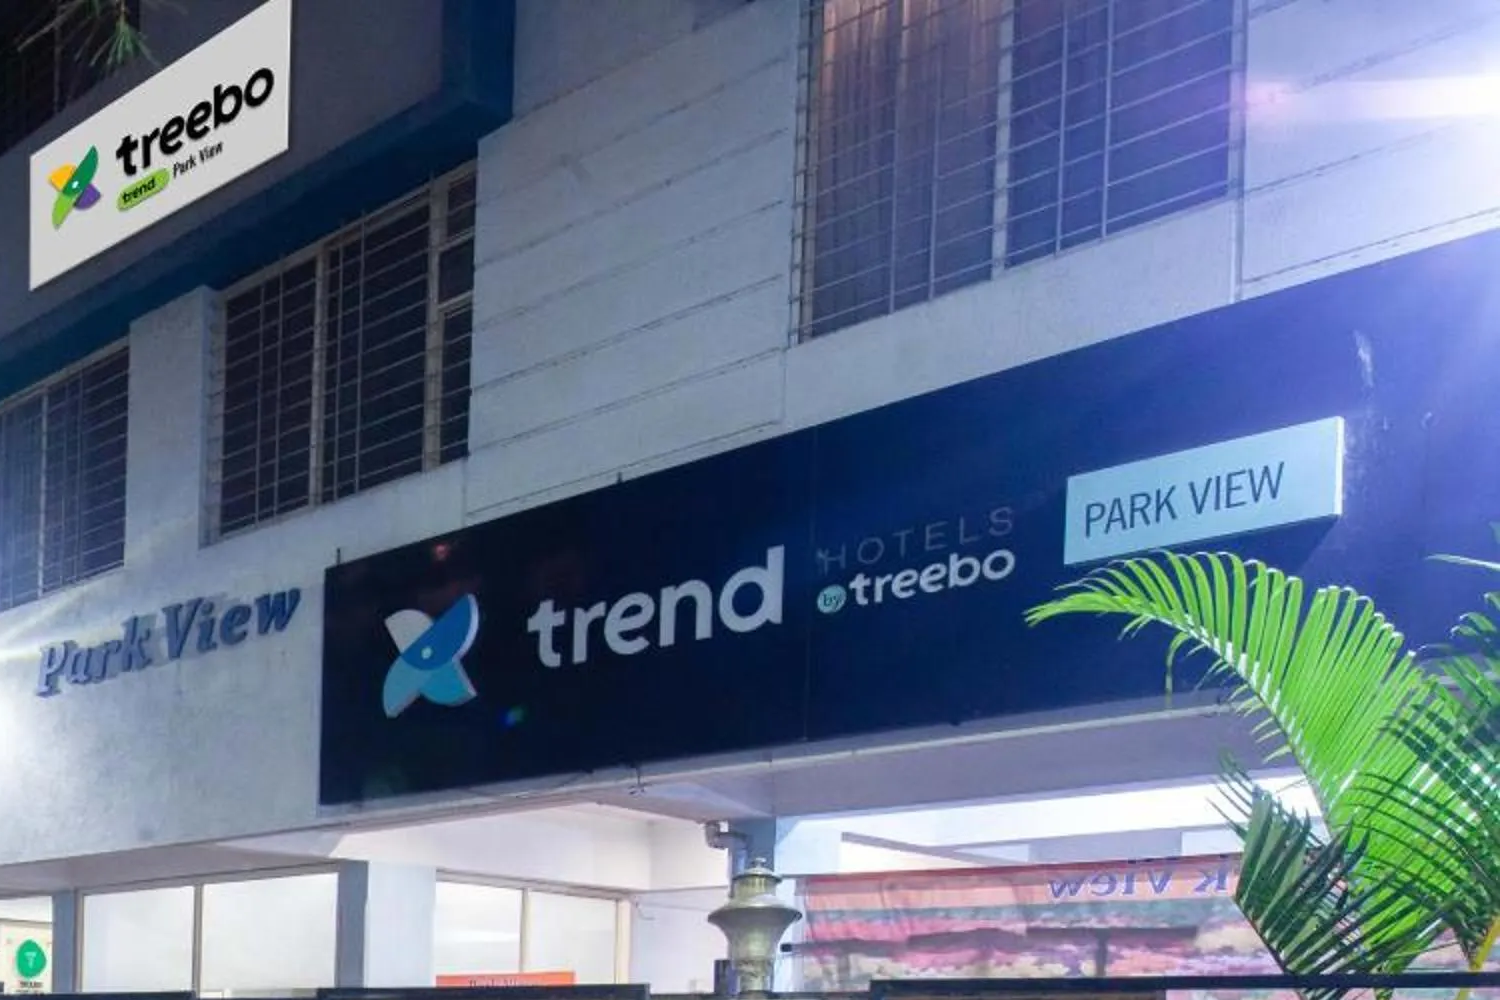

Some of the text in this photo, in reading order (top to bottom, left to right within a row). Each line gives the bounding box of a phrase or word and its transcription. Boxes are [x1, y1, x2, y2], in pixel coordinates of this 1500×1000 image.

[116, 67, 275, 176] treebo
[122, 142, 223, 203] trend Park View
[1084, 461, 1285, 537] PARK VIEW
[816, 506, 1013, 575] HOTELS
[849, 549, 1016, 606] treebo
[36, 587, 302, 697] Park View
[527, 545, 785, 668] trend
